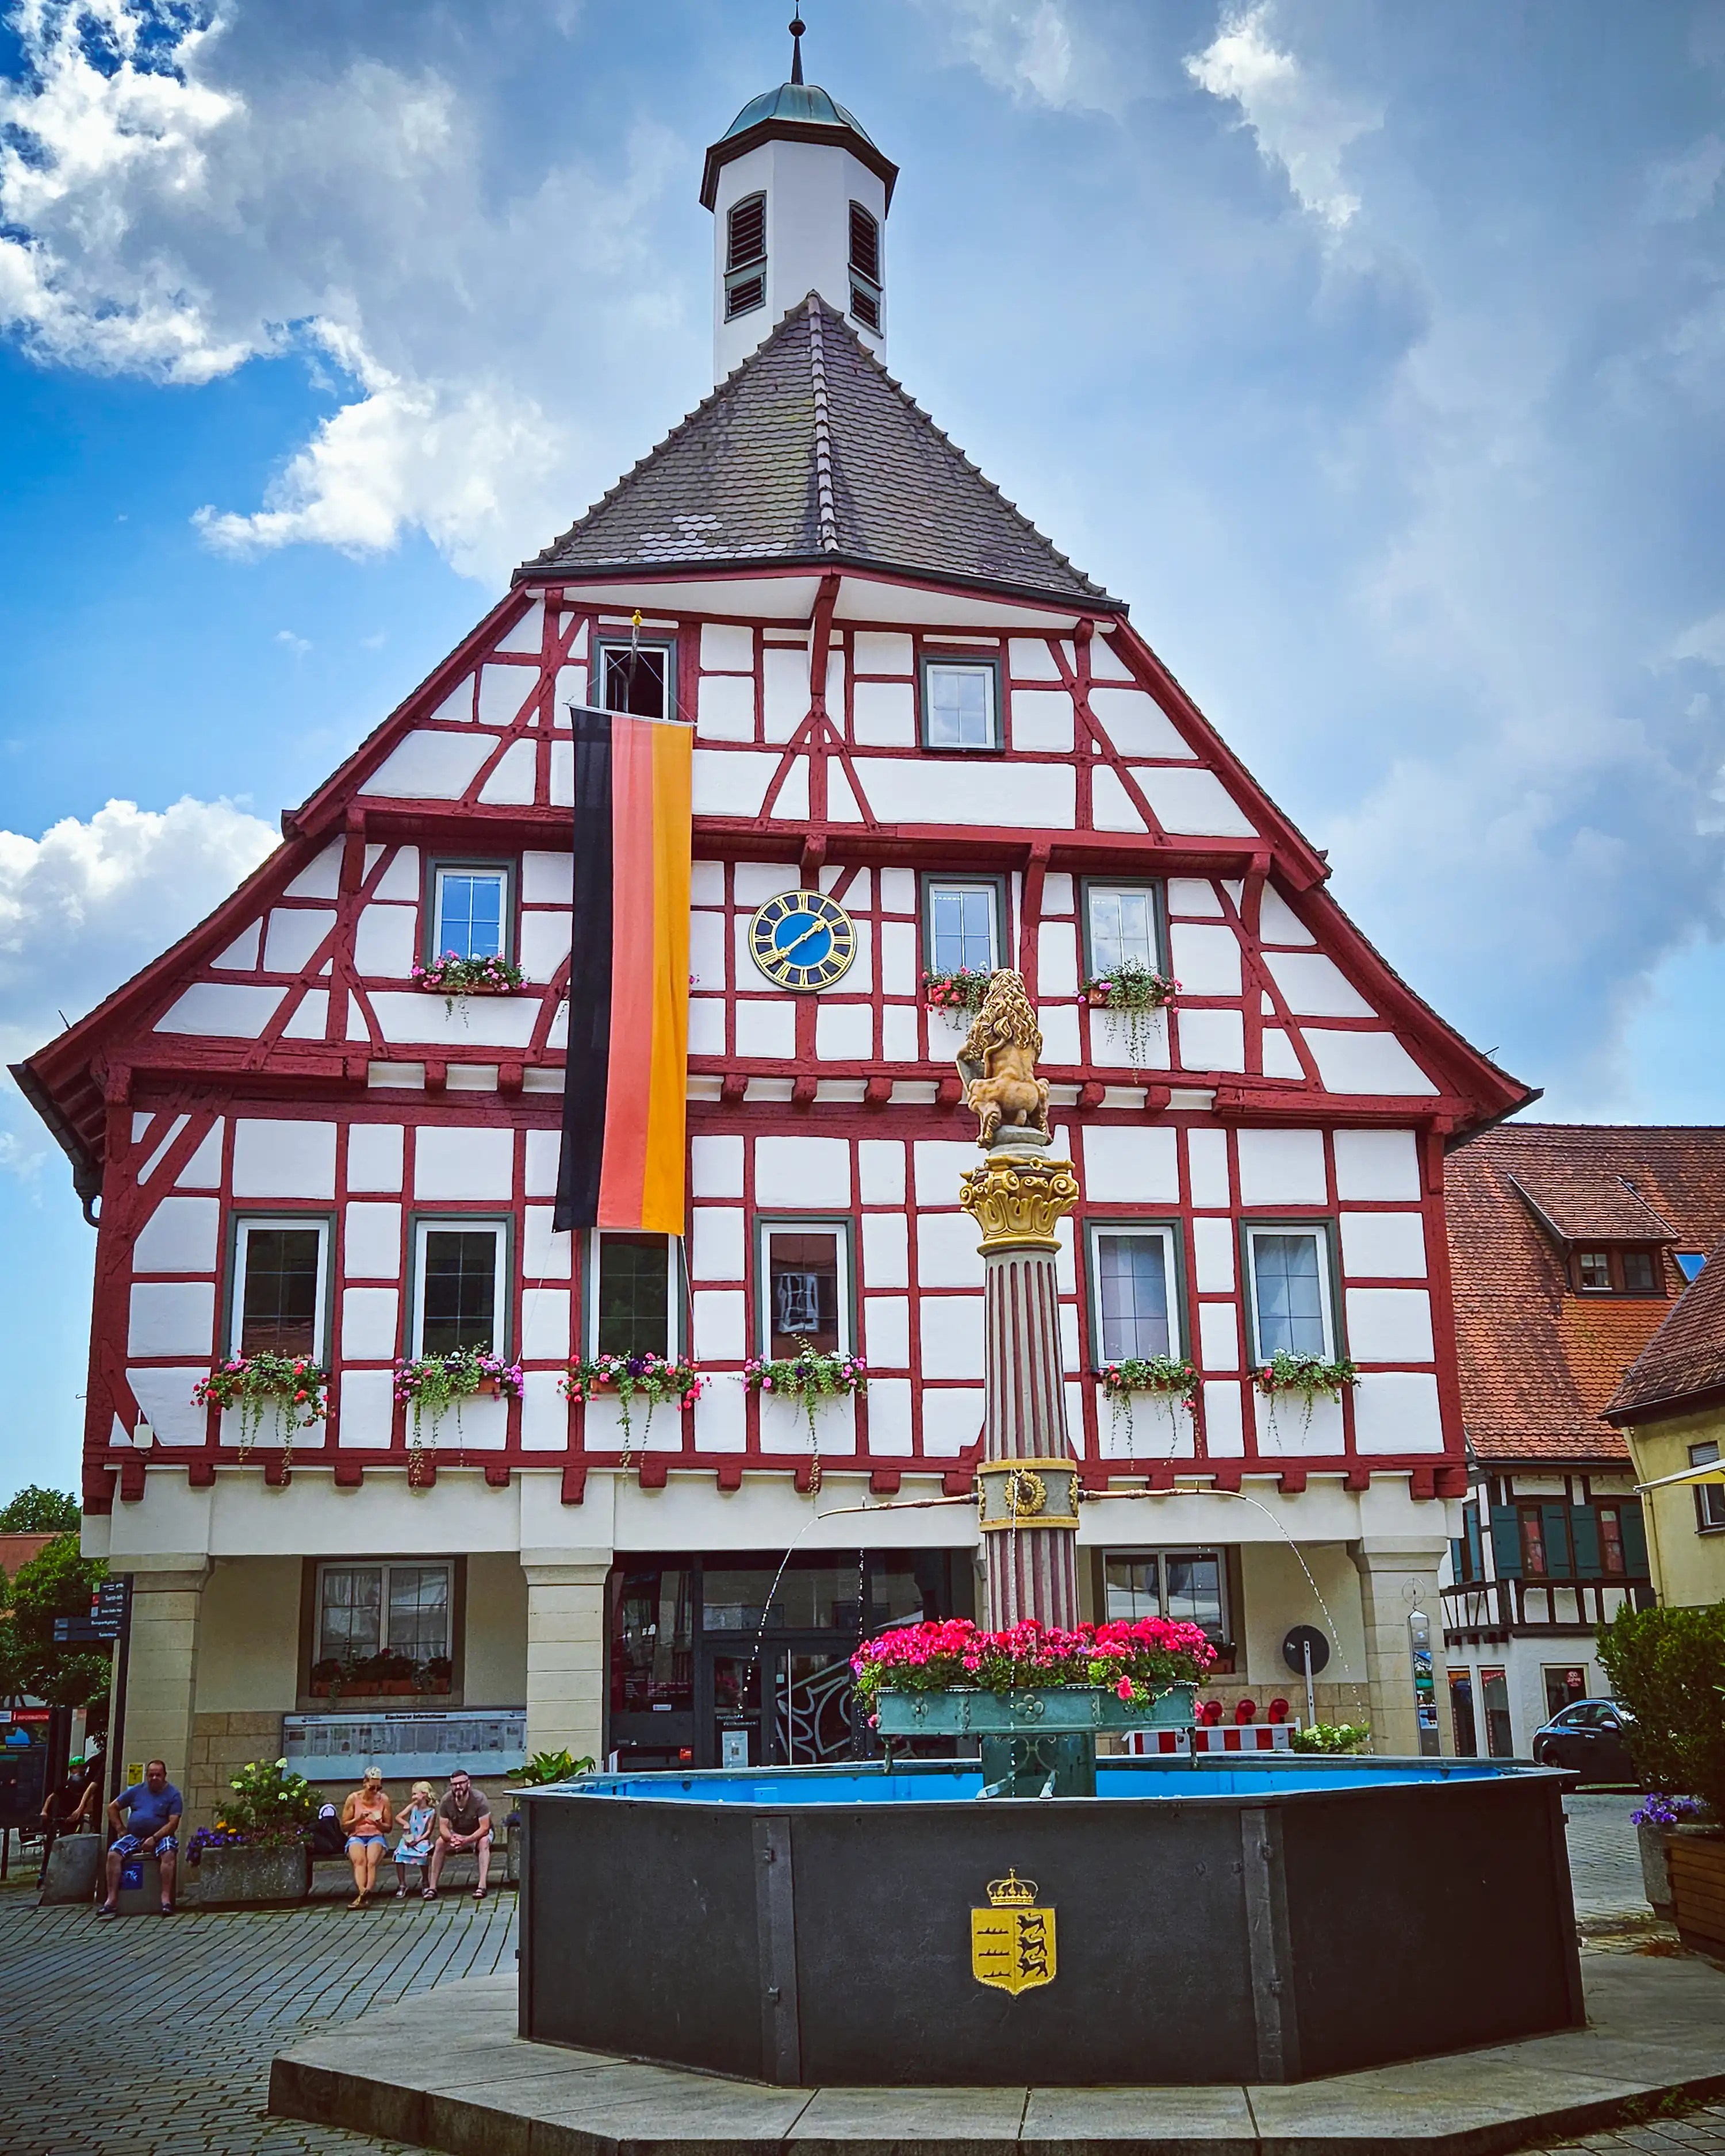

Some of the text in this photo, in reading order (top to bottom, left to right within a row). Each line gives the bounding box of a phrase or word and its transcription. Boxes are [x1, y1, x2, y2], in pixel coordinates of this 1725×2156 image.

[775, 897, 790, 915] XI
[796, 893, 808, 911] XII
[759, 914, 777, 925] X
[754, 934, 772, 943] IX
[834, 935, 852, 945] III
[818, 965, 832, 981] V
